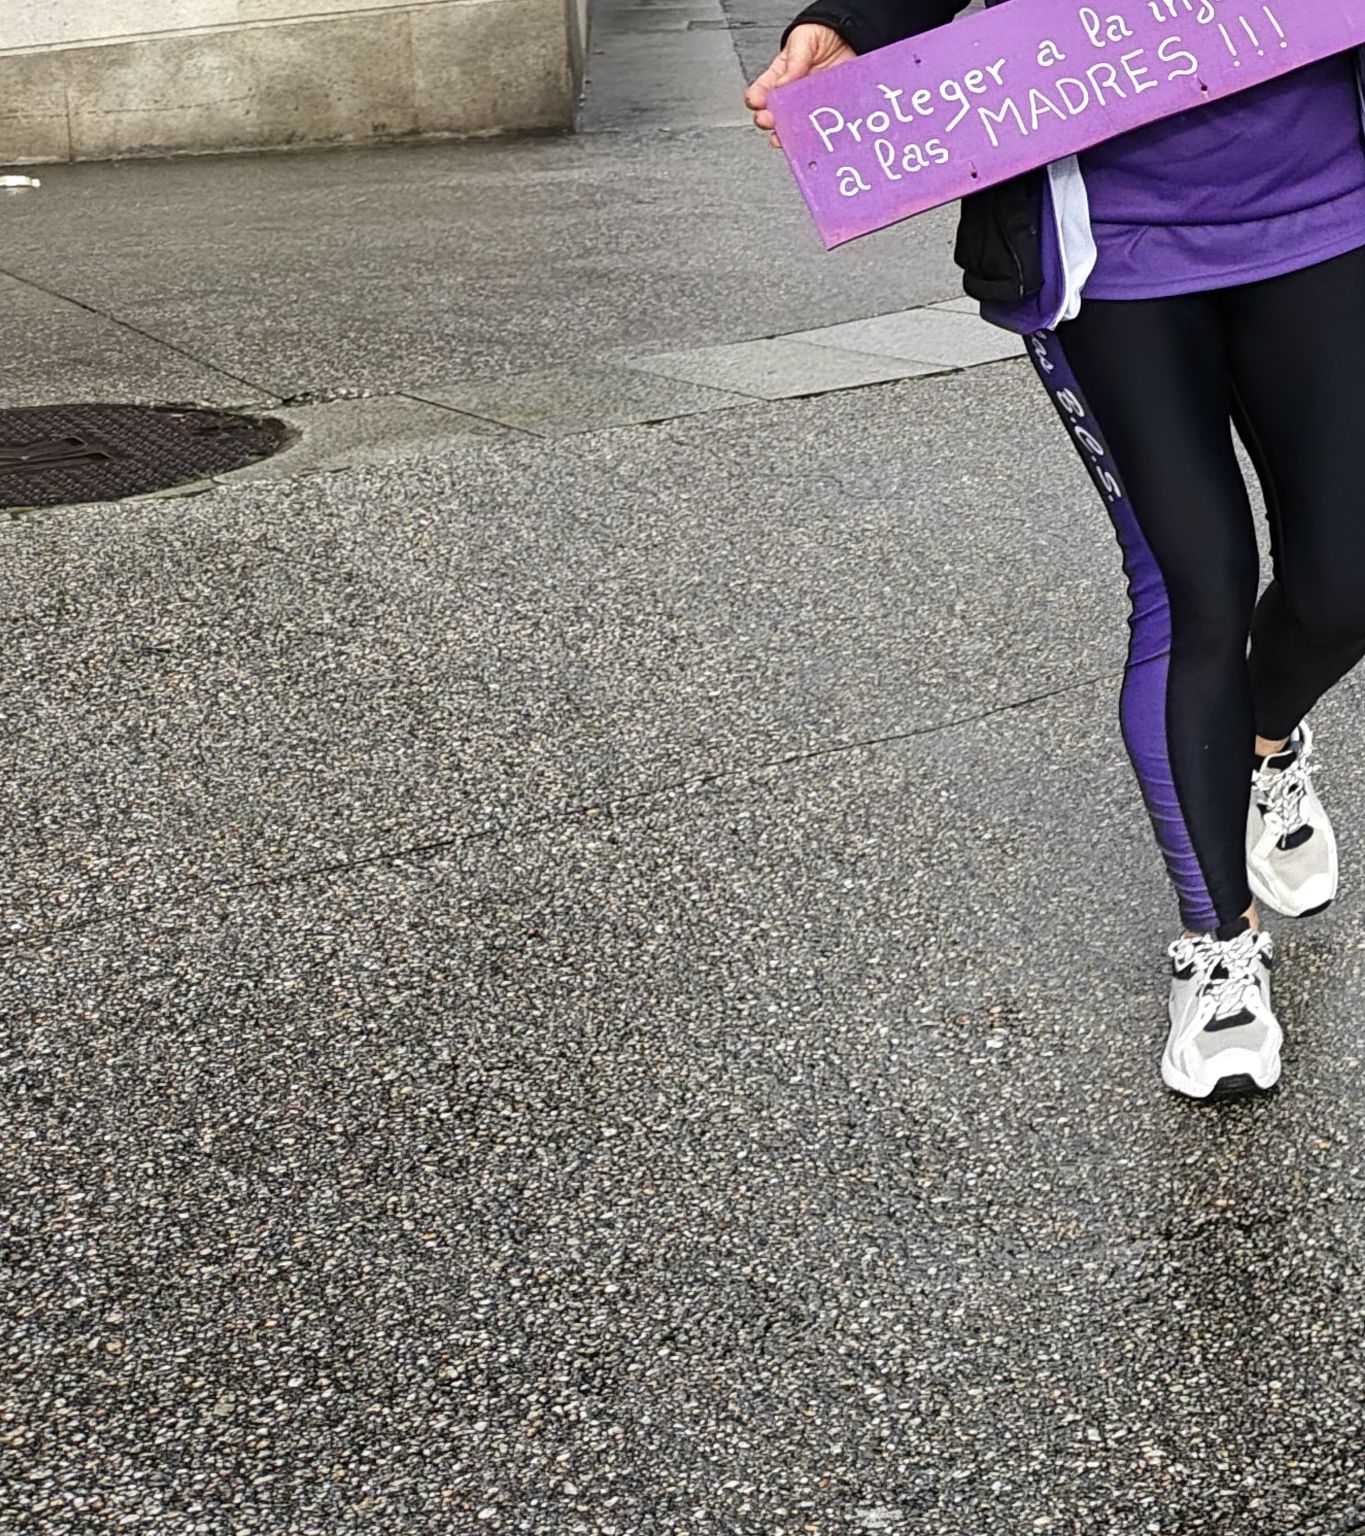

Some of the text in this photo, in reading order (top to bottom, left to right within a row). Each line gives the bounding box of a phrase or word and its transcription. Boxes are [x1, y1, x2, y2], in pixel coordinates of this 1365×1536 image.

[808, 57, 1008, 153] Proteger
[1036, 39, 1066, 67] a
[1078, 6, 1134, 48] la
[834, 5, 1289, 198] a las MADRES !!!
